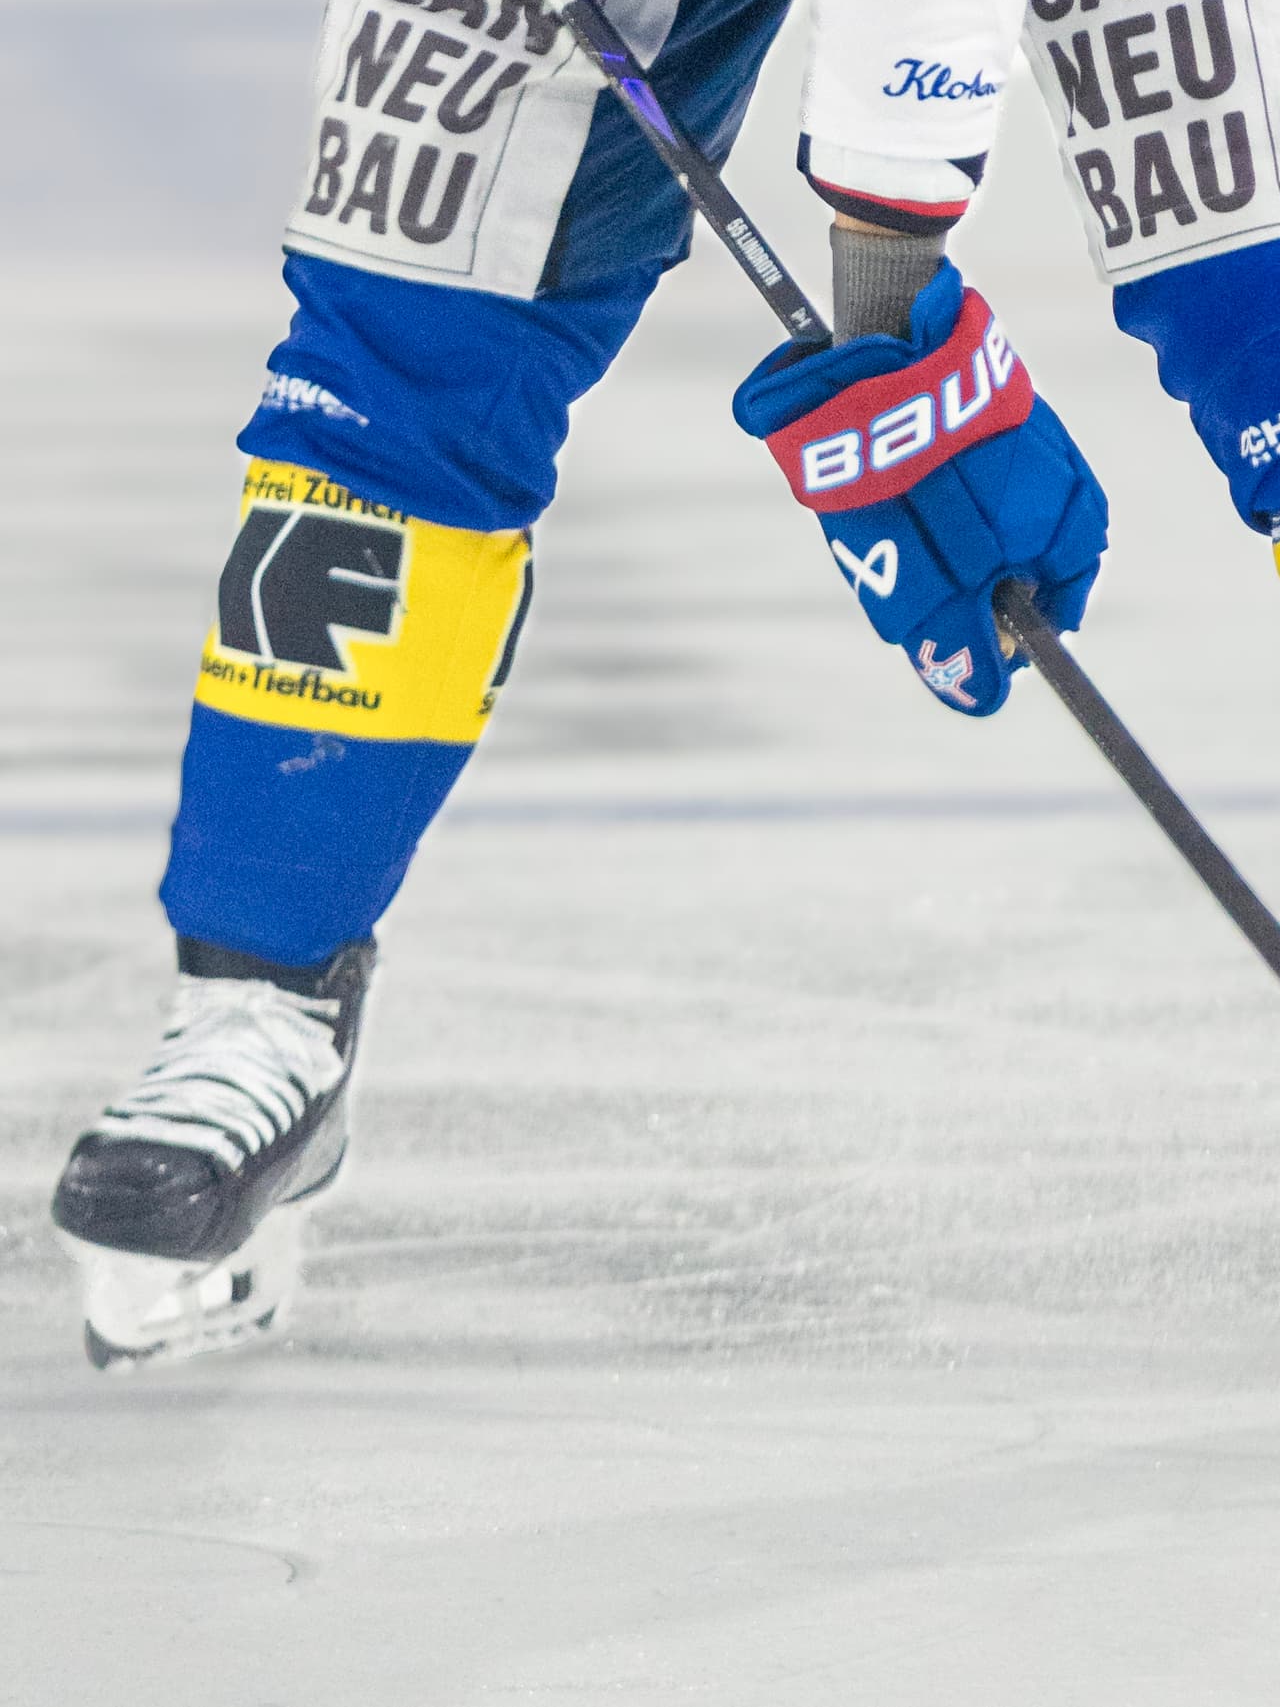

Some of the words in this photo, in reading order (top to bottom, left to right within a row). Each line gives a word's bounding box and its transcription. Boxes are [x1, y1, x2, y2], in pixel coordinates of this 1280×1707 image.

[334, 9, 533, 137] NEU
[304, 115, 479, 246] BAU
[1073, 109, 1257, 250] BAU
[249, 661, 383, 712] Tiefbau
